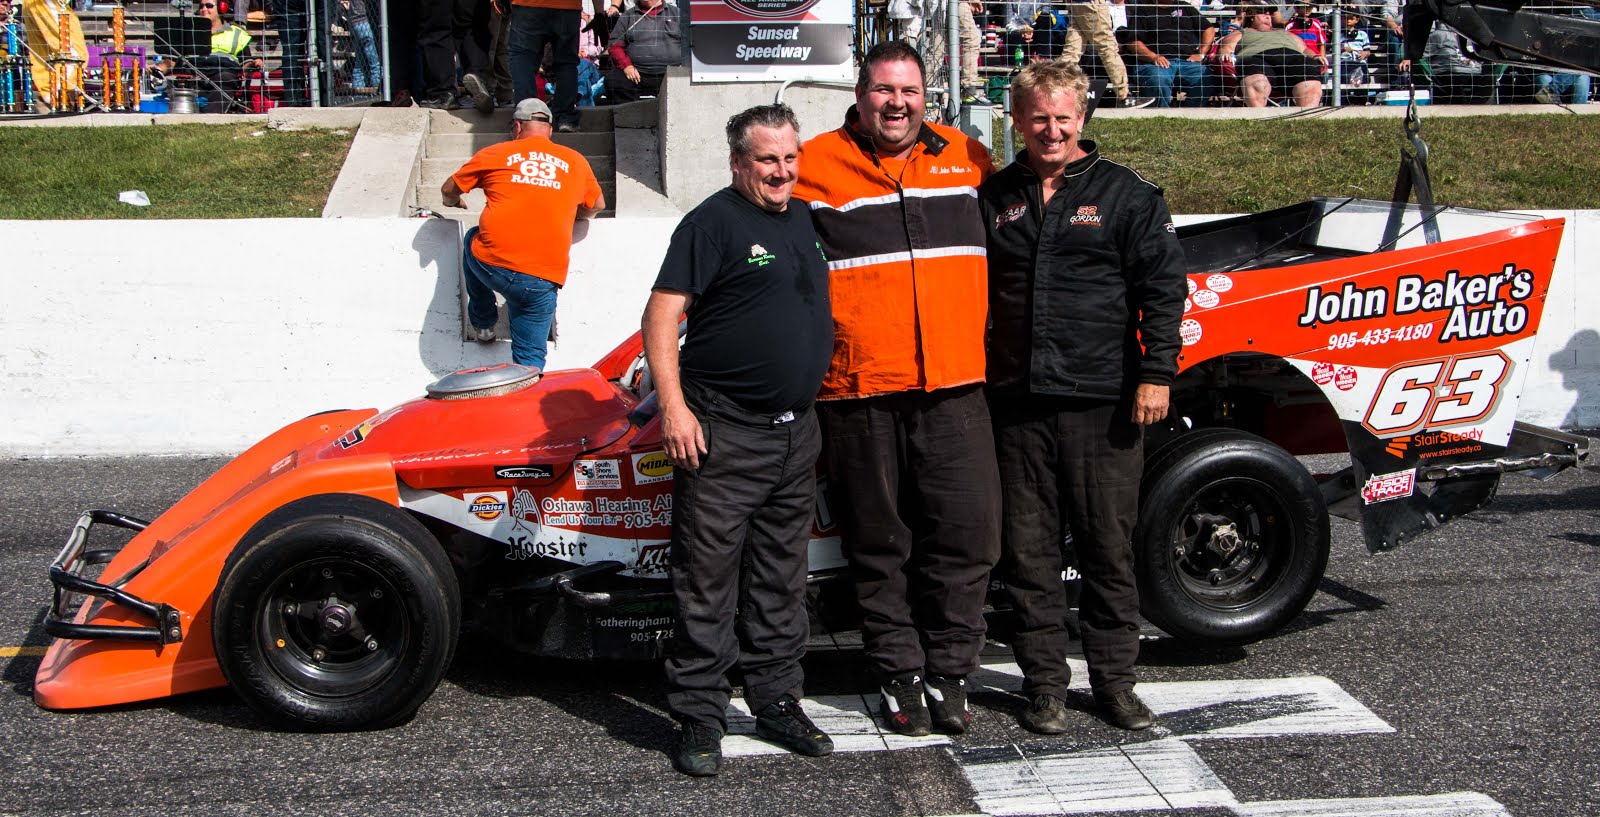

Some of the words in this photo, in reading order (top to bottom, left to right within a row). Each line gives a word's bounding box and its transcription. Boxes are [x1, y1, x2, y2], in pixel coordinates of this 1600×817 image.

[747, 26, 799, 40] Sunset
[735, 44, 812, 61] Speedway
[506, 153, 525, 167] JR.
[528, 151, 569, 174] BAKER
[520, 160, 557, 180] 63
[511, 174, 561, 190] RACING
[1070, 215, 1102, 225] GORDON
[1299, 282, 1387, 326] John
[1394, 264, 1533, 314] Baker's
[1438, 303, 1528, 343] Auto
[1327, 323, 1433, 350] 905-433-4180
[1362, 350, 1513, 437] 63
[1414, 428, 1484, 447] StairSteady
[1419, 445, 1482, 459] www.stairsteady.ca
[471, 503, 503, 512] Dickies
[542, 497, 593, 512] Oshawa
[596, 496, 651, 514] Hearing
[545, 514, 566, 525] Lend
[567, 514, 579, 525] Us
[581, 514, 602, 525] Your
[505, 535, 587, 560] Hoosier
